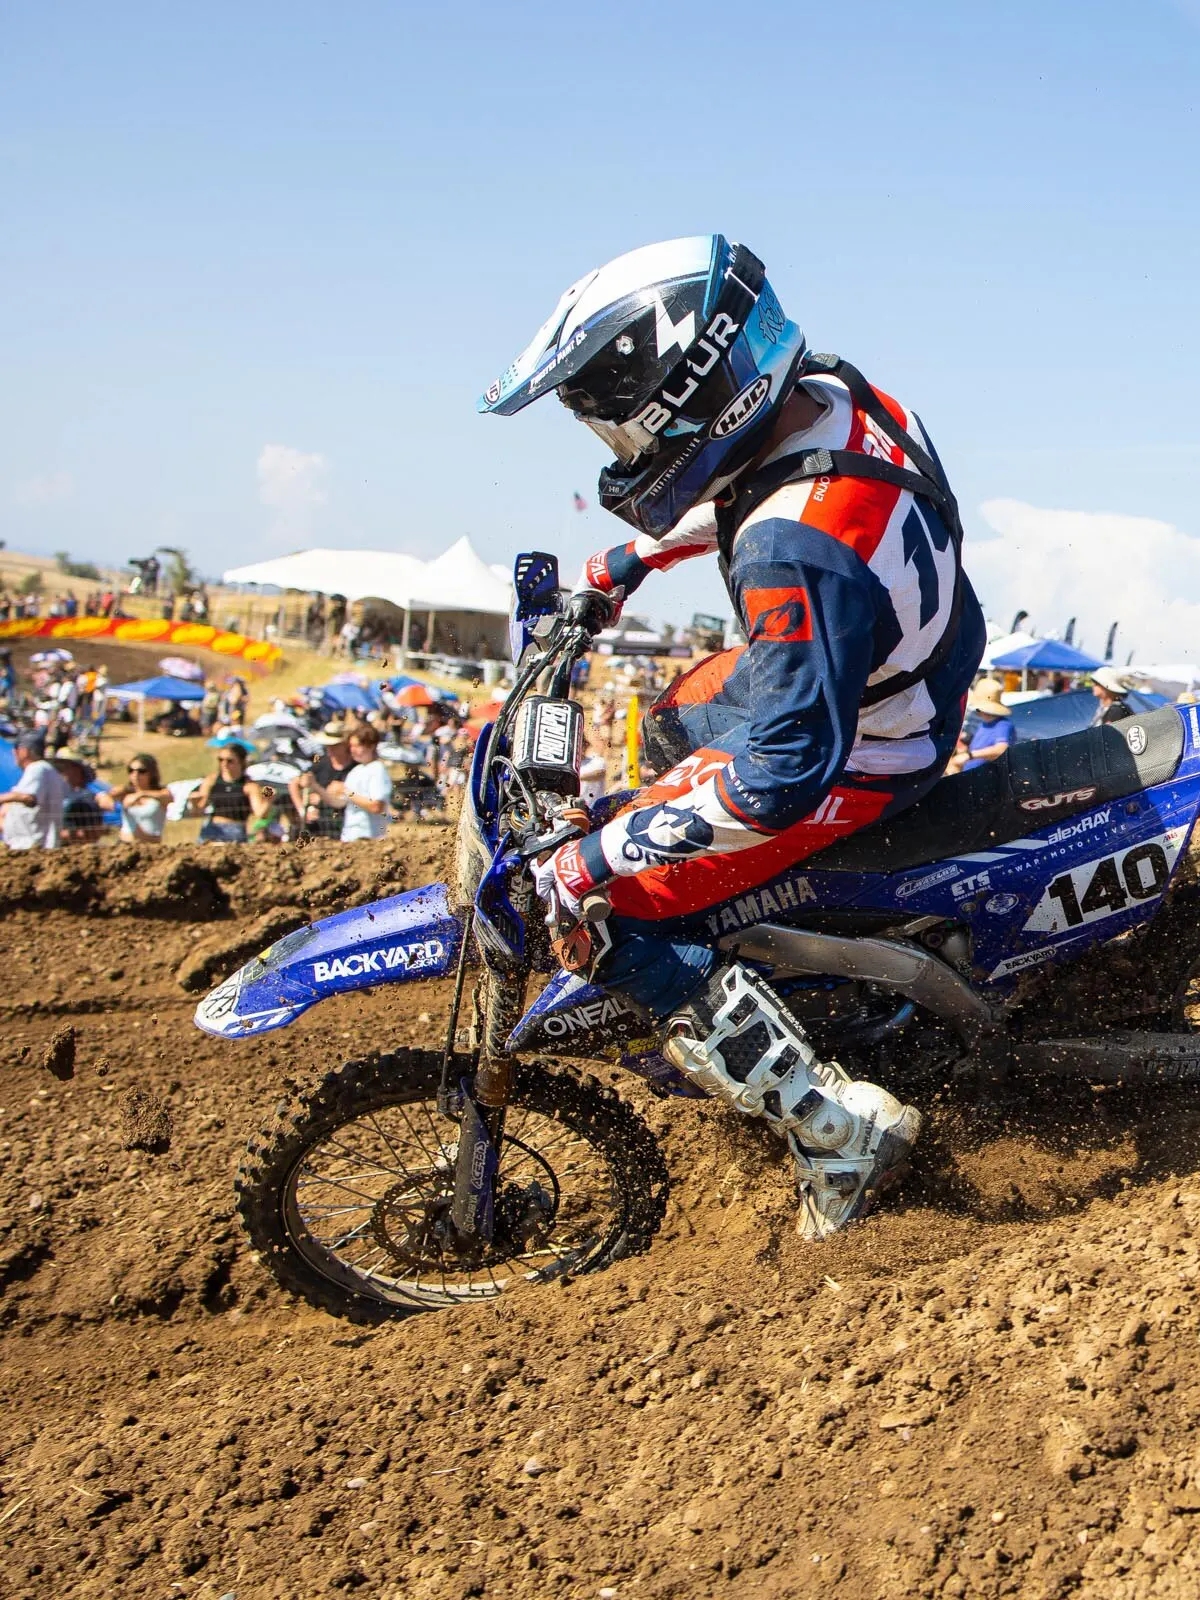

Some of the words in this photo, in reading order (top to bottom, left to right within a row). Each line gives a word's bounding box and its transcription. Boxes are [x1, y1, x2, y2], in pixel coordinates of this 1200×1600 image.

[636, 312, 740, 434] BLUR
[719, 378, 767, 434] HJC
[813, 475, 831, 502] ENJO
[590, 552, 607, 585] EAL
[537, 705, 568, 760] PROTAPER
[734, 779, 761, 809] BRAND
[1020, 787, 1096, 811] GUTS
[1051, 841, 1083, 858] MOTO
[1095, 824, 1127, 841] LIVE
[559, 841, 587, 893] NEAL
[951, 870, 990, 897] ETS
[1048, 842, 1170, 927] 140
[705, 876, 818, 936] YAMAHA
[312, 940, 444, 982] BACKYARD
